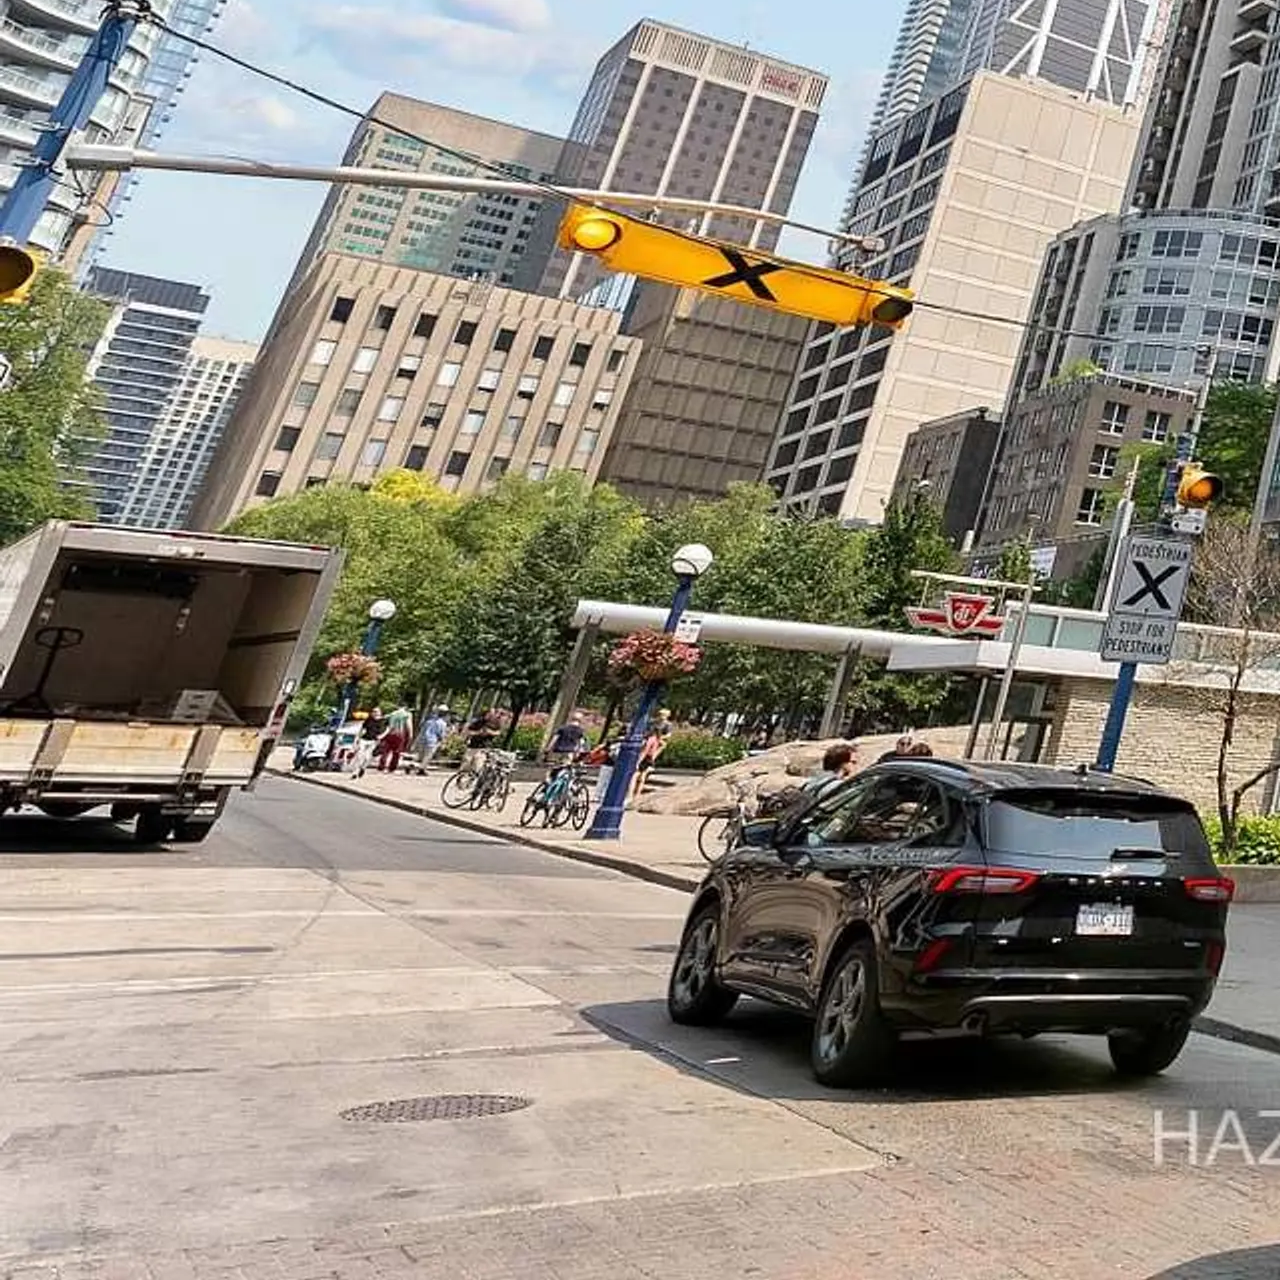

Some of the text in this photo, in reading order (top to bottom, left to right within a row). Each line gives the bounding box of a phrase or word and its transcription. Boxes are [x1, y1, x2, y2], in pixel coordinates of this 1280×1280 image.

[1119, 621, 1166, 638] STOP FOR
[1104, 638, 1170, 657] PEDESTRIANS
